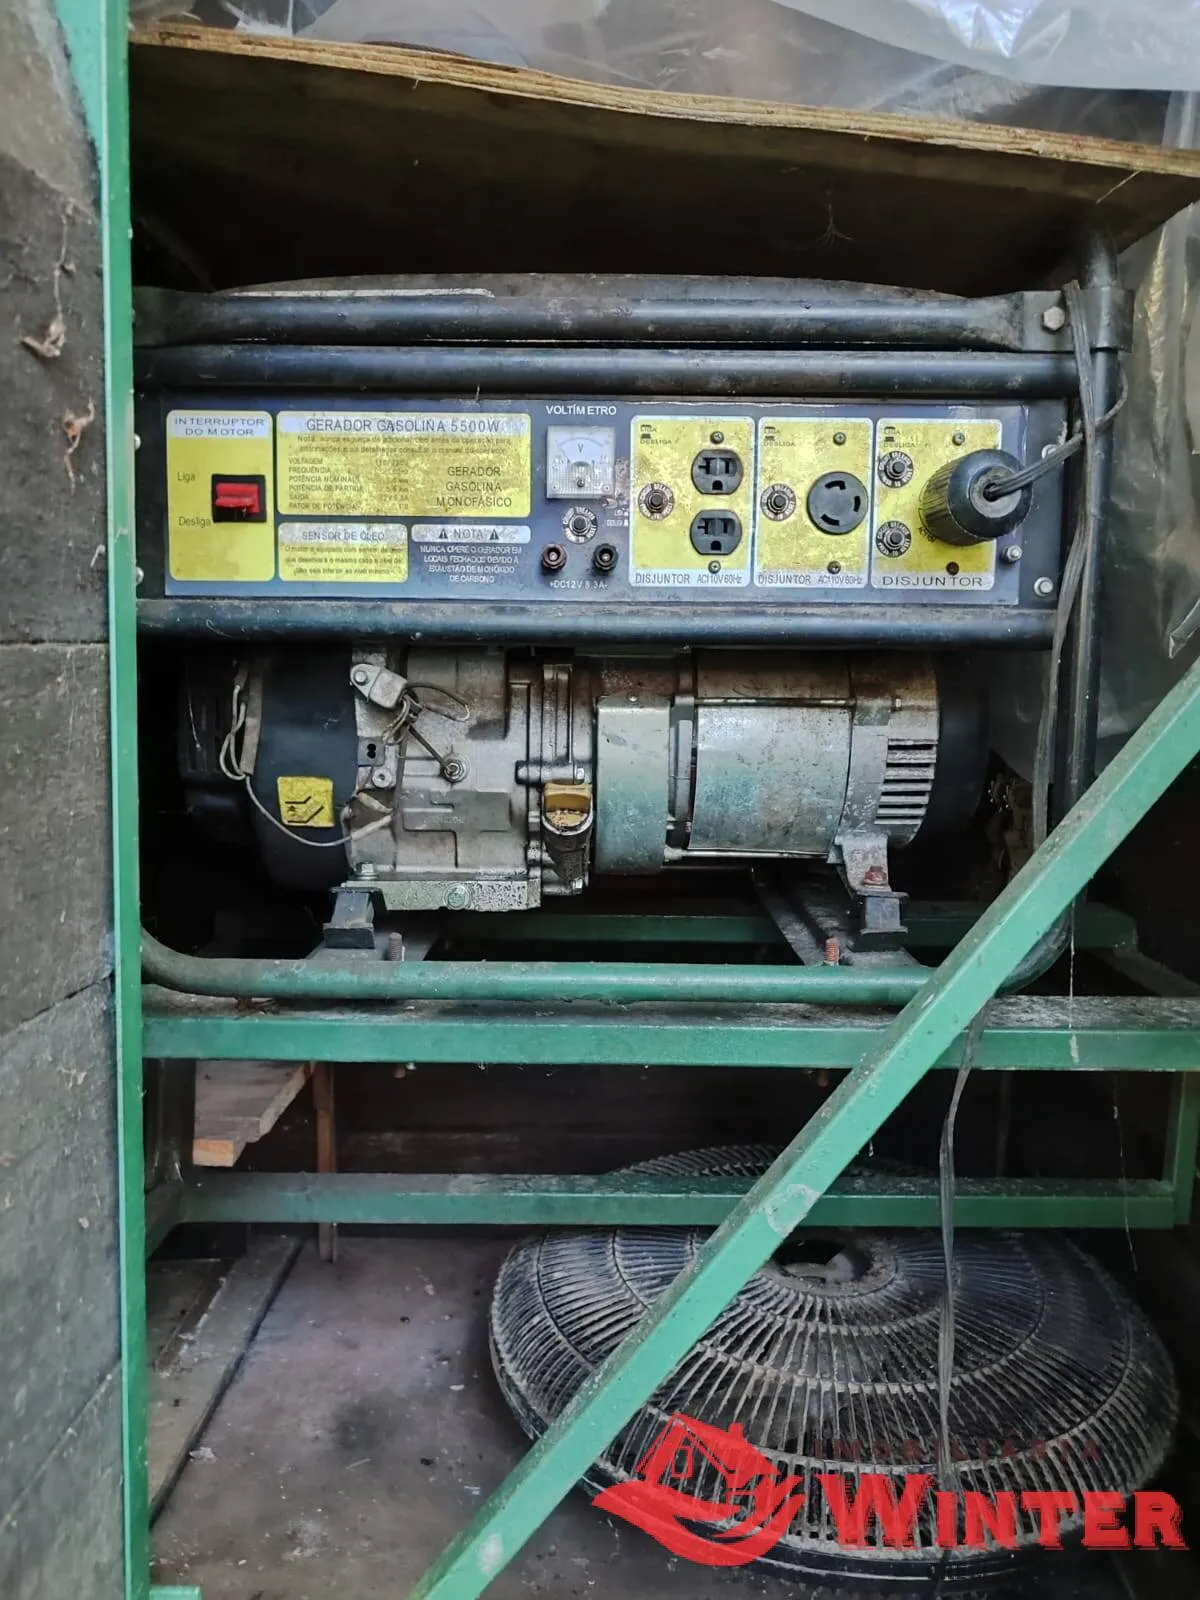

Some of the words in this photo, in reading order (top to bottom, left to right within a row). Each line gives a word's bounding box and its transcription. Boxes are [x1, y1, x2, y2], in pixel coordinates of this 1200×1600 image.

[546, 404, 617, 415] VOLTÍMETRO
[175, 417, 265, 426] INTERRUPTOR
[306, 419, 372, 432] GERADOR
[377, 419, 446, 432] GASOLINA
[451, 420, 500, 432] 5500W
[185, 428, 204, 436] DO
[208, 428, 254, 436] MOTOR
[177, 472, 196, 482] Liga
[447, 466, 501, 477] GERADOR
[445, 481, 503, 493] GASOLINA
[435, 496, 512, 508] MONOFÁSICO
[178, 516, 211, 527] Desliga
[301, 531, 341, 541] SENSOR
[344, 531, 357, 541] DE
[360, 528, 385, 541] ÓLEO
[453, 528, 483, 539] NOTA
[420, 545, 446, 553] NUNCA
[635, 573, 690, 584] DISJUNTOR
[758, 573, 811, 584] DISJUNTOR
[882, 576, 983, 587] DISJUNTOR
